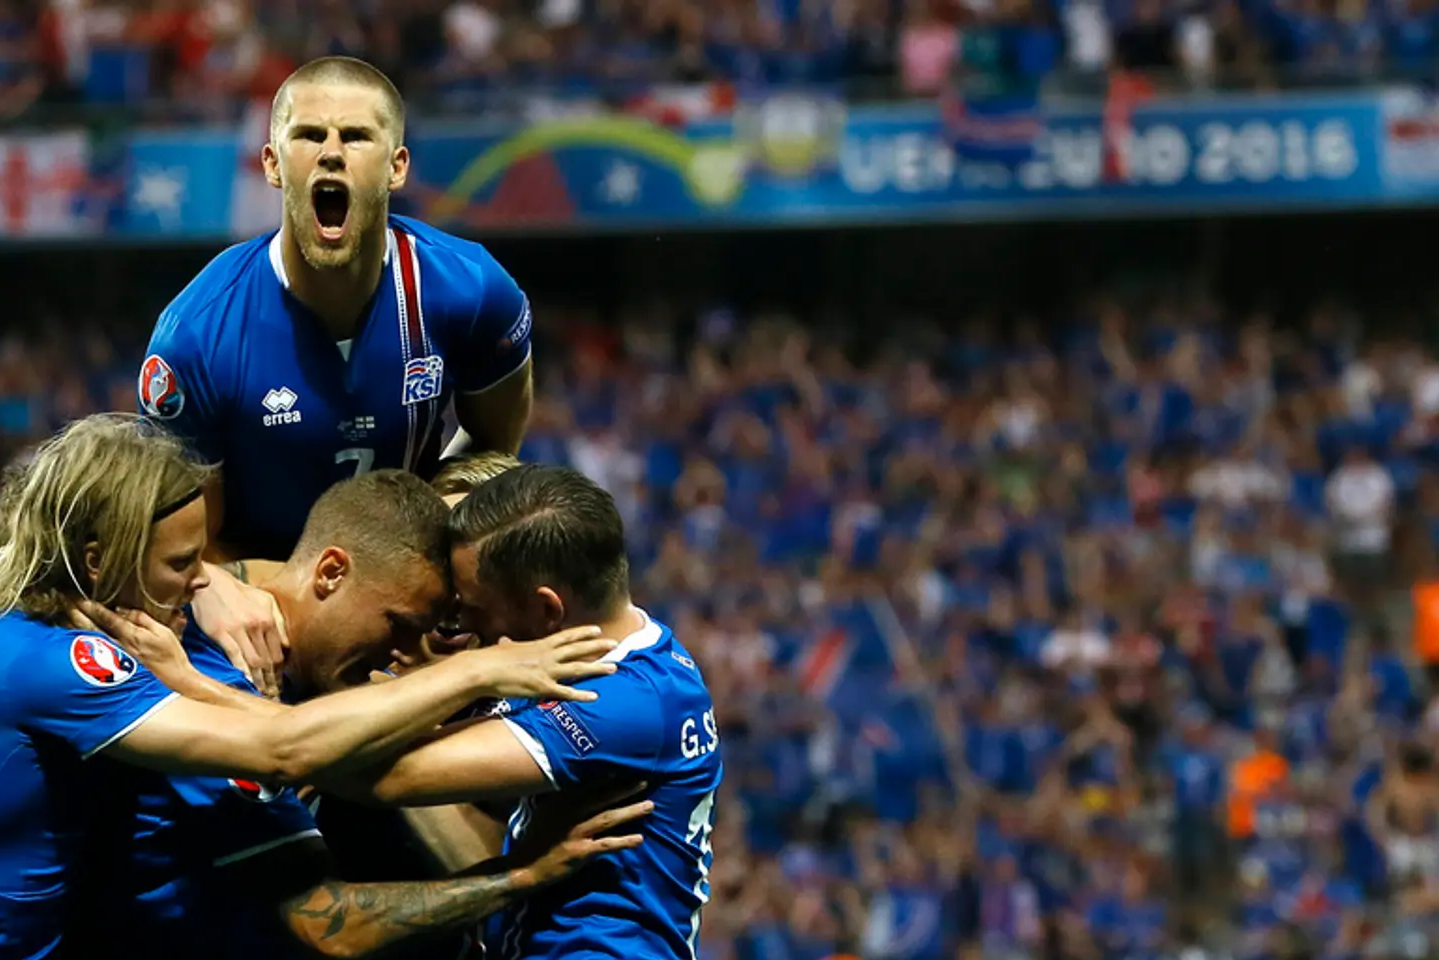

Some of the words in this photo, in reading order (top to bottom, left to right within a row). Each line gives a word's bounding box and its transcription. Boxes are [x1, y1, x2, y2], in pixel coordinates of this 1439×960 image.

[1196, 119, 1358, 184] 2016
[262, 410, 302, 427] errea
[335, 448, 375, 479] 7
[552, 704, 595, 752] RESPECT
